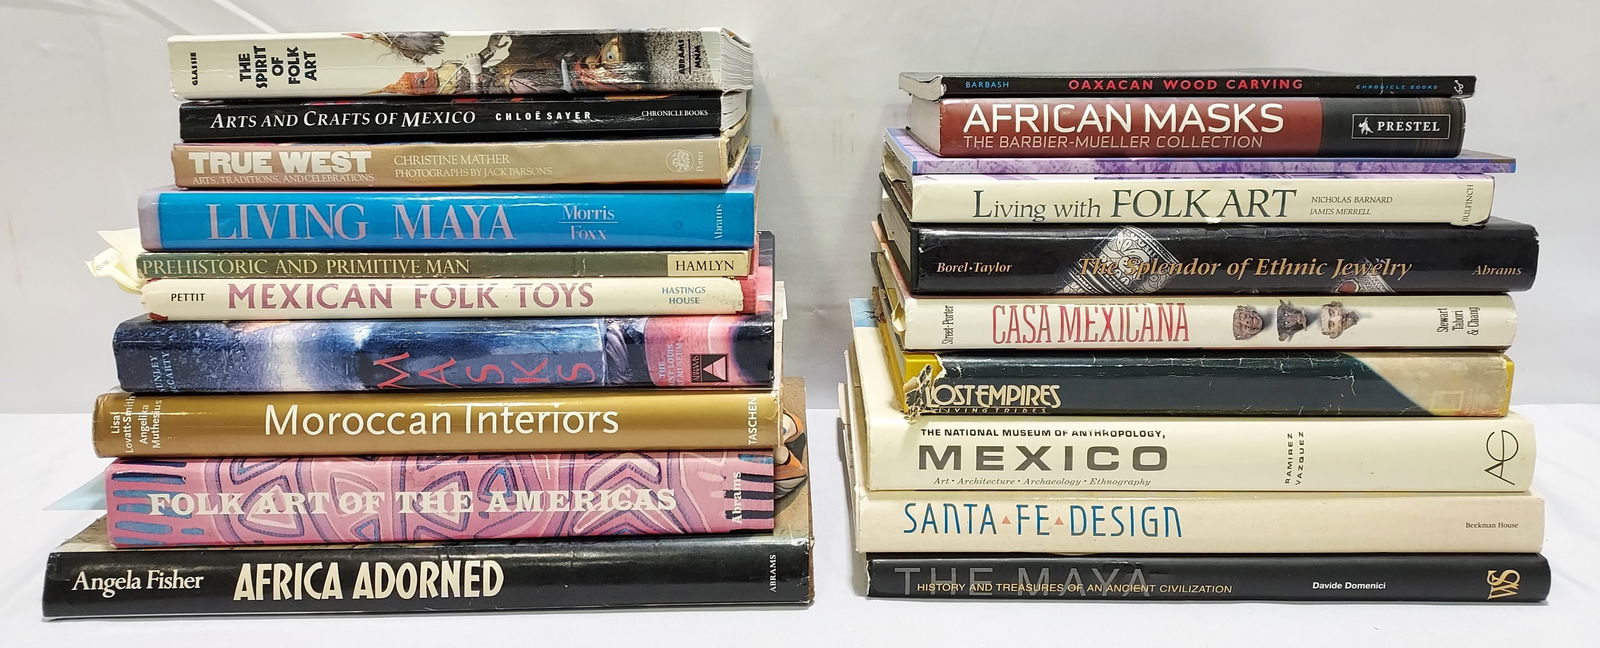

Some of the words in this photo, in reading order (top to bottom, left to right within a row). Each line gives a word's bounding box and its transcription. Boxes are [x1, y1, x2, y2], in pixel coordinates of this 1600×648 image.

[239, 52, 252, 82] THE
[254, 46, 268, 89] SPIRIT
[271, 57, 284, 77] OF
[287, 46, 301, 85] FOLK
[303, 51, 318, 82] ART
[966, 81, 1010, 89] BARBASH
[1068, 79, 1153, 90] OAXACAN
[1162, 79, 1218, 90] WOOD
[1226, 79, 1304, 90] CARVING
[210, 113, 258, 129] ARTS
[261, 114, 298, 127] AND
[303, 110, 371, 127] CRAFTS
[375, 112, 399, 125] OF
[401, 110, 476, 128] MEXICO
[496, 110, 542, 121] CHLOË
[547, 111, 591, 121] SAYER
[642, 109, 685, 118] CHRONICLE
[963, 103, 1131, 133] AFRICAN
[1146, 103, 1284, 133] MASKS
[1377, 120, 1441, 133] PRESTEL
[963, 136, 994, 149] THE
[1000, 136, 1150, 149] BARBIER-MUELLER
[1156, 136, 1264, 149] COLLECTION
[188, 152, 273, 175] TRUE
[279, 151, 372, 174] WEST
[394, 155, 458, 166] CHRISTINE
[460, 154, 511, 165] MATHER
[282, 175, 305, 183] AND
[305, 174, 375, 183] CELEBRATIONS
[395, 168, 469, 178] PHOTOGRAPHS
[470, 168, 482, 176] BY
[482, 167, 509, 177] JACK
[510, 167, 553, 176] PARSONS
[972, 190, 1047, 222] Living
[1054, 198, 1101, 218] with
[1110, 189, 1211, 218] FOLK
[1218, 189, 1297, 218] ART
[1312, 196, 1352, 204] NICHOLAS
[1354, 196, 1393, 204] BARNARD
[1462, 184, 1474, 223] BULFINCH
[207, 203, 369, 241] LIVING
[392, 204, 518, 240] MAYA
[563, 205, 615, 221] Morris
[1310, 208, 1335, 216] JAMES
[1335, 208, 1371, 216] MERRELL
[570, 226, 607, 240] Foxx
[142, 259, 267, 276] PREHISTORIC
[275, 259, 318, 274] AND
[326, 259, 421, 274] PRIMITIVE
[426, 259, 471, 274] MAN
[676, 260, 735, 272] HAMLYN
[1080, 257, 1119, 276] The
[1126, 257, 1222, 279] Splendor
[1227, 257, 1253, 280] of
[1254, 257, 1327, 276] Ethnic
[1331, 257, 1413, 280] Jewelry
[1472, 264, 1522, 276] Abrams
[171, 292, 206, 302] PETTIT
[228, 283, 393, 310] MEXICAN
[414, 282, 500, 309] FOLK
[514, 282, 594, 309] TOYS
[662, 286, 706, 295] HASTINGS
[669, 297, 700, 305] HOUSE
[992, 304, 1051, 344] CASA
[1058, 302, 1190, 344] MEXICANA
[1437, 308, 1449, 333] Stewart
[1452, 310, 1464, 331] Tabori
[1467, 307, 1481, 328] Chang
[373, 352, 596, 390] MASKS
[975, 384, 1062, 409] EMPIRES
[111, 412, 120, 434] Lisa
[122, 396, 136, 453] Lovatt-Smith
[138, 404, 150, 445] Angelika
[150, 400, 162, 449] Muthesius
[265, 404, 451, 436] Moroccan
[466, 402, 620, 435] Interiors
[748, 397, 758, 446] TASCHEN
[921, 429, 942, 437] THE
[944, 429, 999, 437] NATIONAL
[1002, 429, 1051, 437] MUSEUM
[1072, 430, 1166, 439] ANTHROPOLOGY,
[919, 445, 1168, 471] MEXICO
[1285, 433, 1293, 485] RAMIREZ
[1296, 431, 1305, 486] VAZQUEZ
[934, 478, 950, 486] Art
[957, 478, 1016, 486] Architecture
[1023, 478, 1082, 487] Archaeology
[1090, 478, 1152, 487] Ethnography
[147, 493, 245, 516] FOLK
[255, 492, 330, 515] ART
[336, 492, 386, 515] OF
[396, 491, 475, 514] THE
[486, 489, 677, 513] AMERICAS
[732, 472, 743, 525] Abrams
[904, 503, 998, 535] SANTA
[1016, 504, 1051, 536] FE
[1070, 505, 1182, 538] DESIGN
[72, 570, 142, 598] Angela
[146, 570, 205, 590] Fisher
[233, 562, 343, 601] AFRICA
[352, 560, 504, 600] ADORNED
[769, 554, 777, 593] ABRAMS
[895, 568, 994, 596] THE
[1018, 568, 1151, 597] MAYA
[917, 583, 966, 593] HISTORY
[969, 583, 993, 592] AND
[996, 583, 1065, 593] TREASURES
[1067, 584, 1084, 593] OF
[1087, 584, 1104, 593] AN
[1105, 584, 1156, 593] ANCIENT
[1160, 584, 1233, 594] CIVILIZATION
[1312, 581, 1342, 590] Davide
[1344, 581, 1386, 590] Domenici
